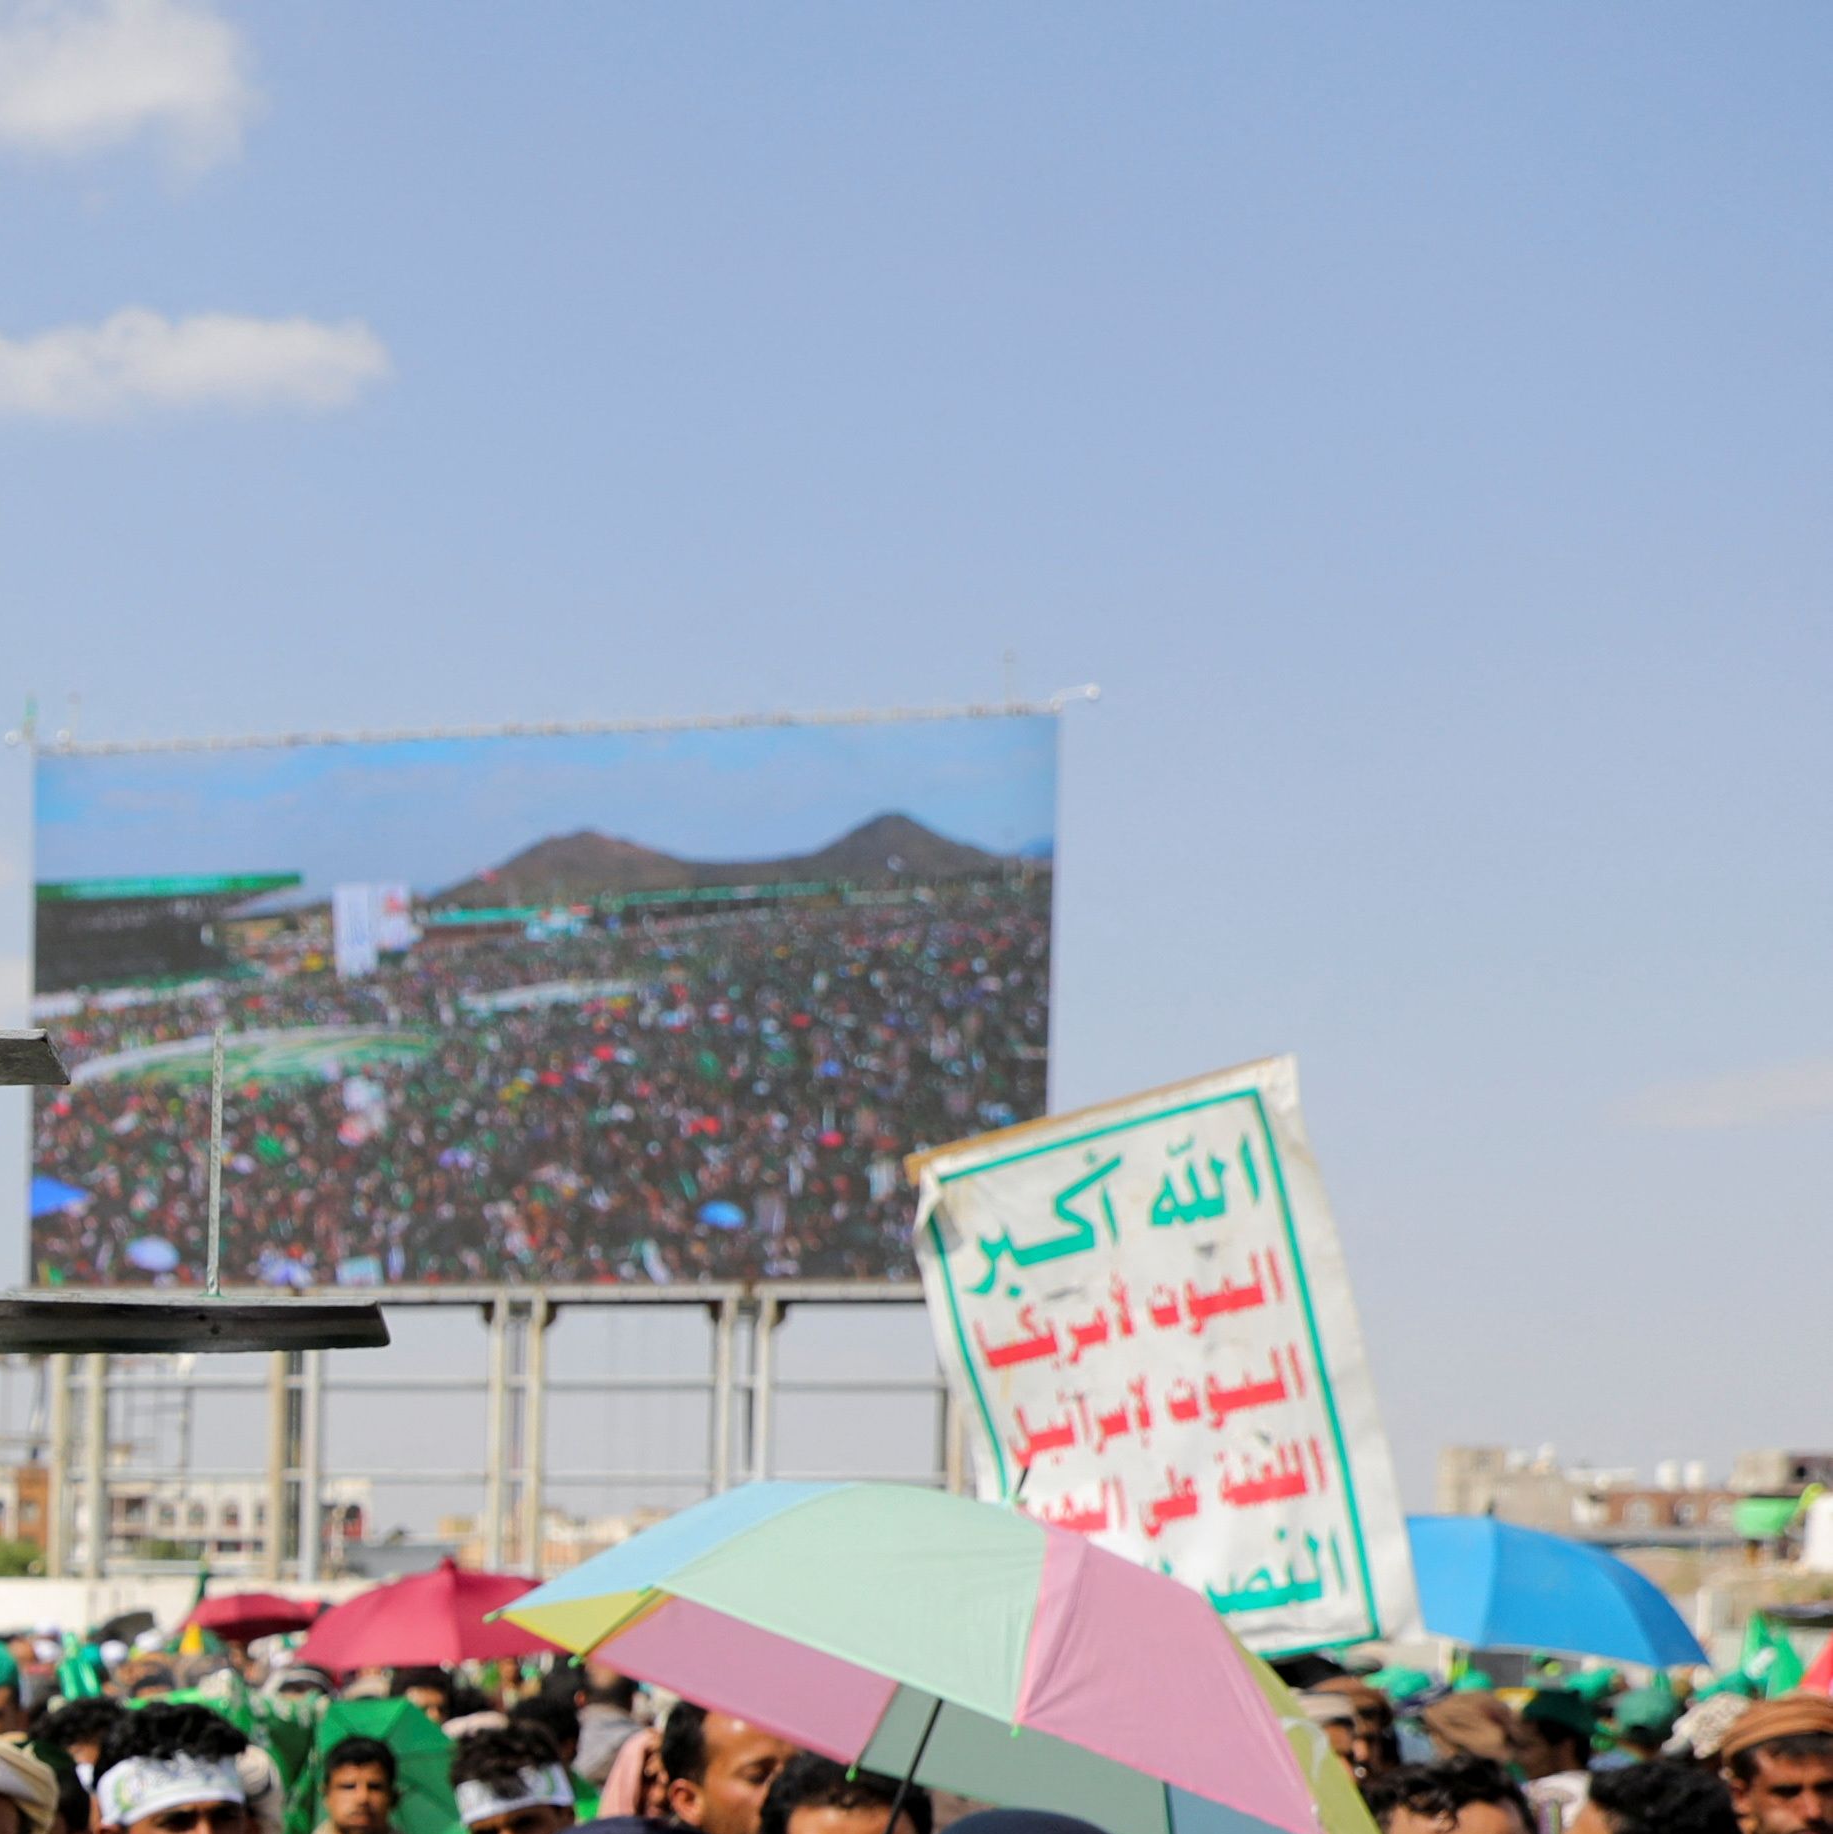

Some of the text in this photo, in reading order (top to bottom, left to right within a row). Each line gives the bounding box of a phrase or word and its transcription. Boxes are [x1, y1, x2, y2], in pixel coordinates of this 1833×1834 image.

[1148, 1132, 1261, 1227] الله
[1148, 1247, 1287, 1337] الموت
[1165, 1341, 1309, 1431] الموت
[1141, 1466, 1200, 1540] على
[1217, 1436, 1329, 1510] اللعنة
